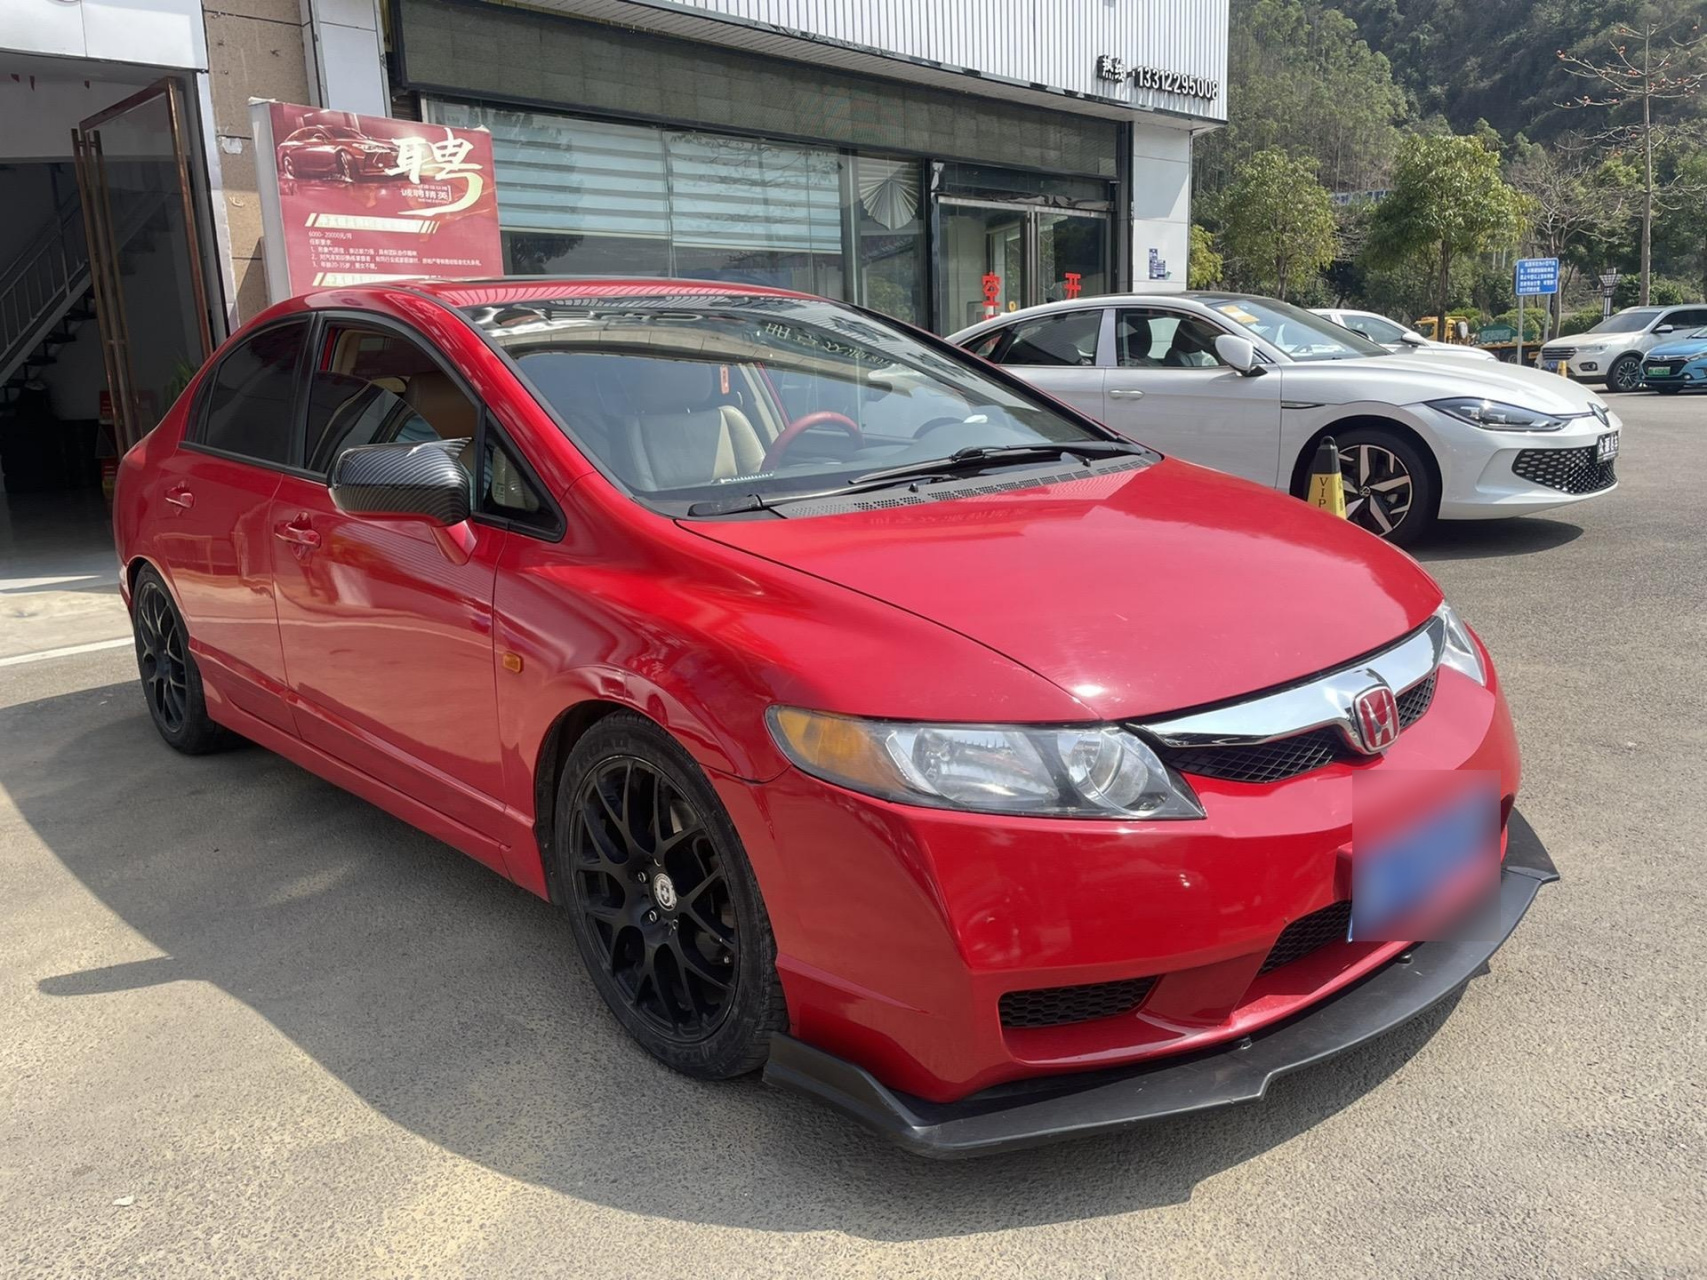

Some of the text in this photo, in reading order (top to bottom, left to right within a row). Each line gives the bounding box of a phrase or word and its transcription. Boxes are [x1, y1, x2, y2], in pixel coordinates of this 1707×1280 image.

[1137, 65, 1219, 99] 13312295008
[385, 127, 483, 216] 聘
[982, 271, 1001, 320] 空
[1318, 477, 1329, 509] VIP
